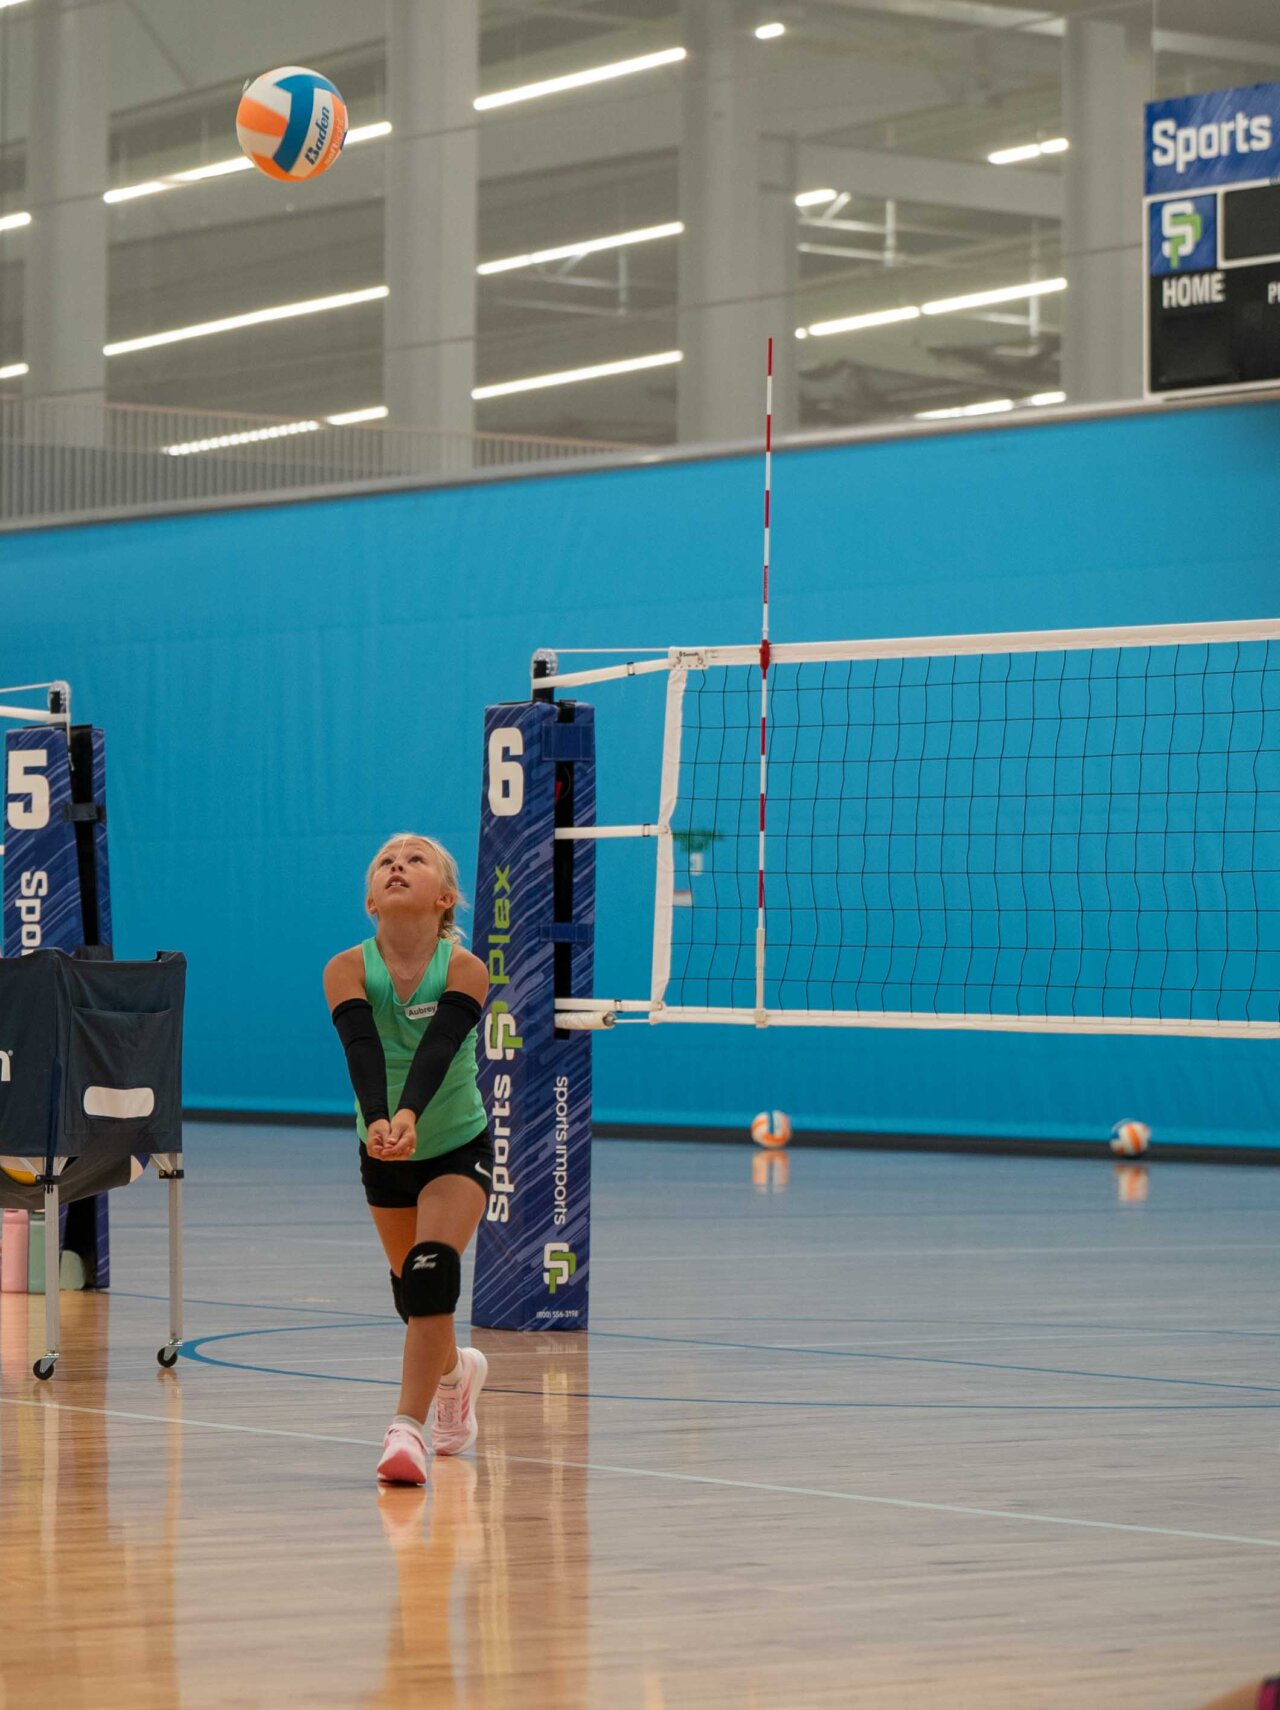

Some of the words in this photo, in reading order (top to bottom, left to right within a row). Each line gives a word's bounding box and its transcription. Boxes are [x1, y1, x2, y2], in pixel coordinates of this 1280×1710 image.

[304, 106, 330, 166] Baden
[1151, 110, 1272, 174] Sports
[1162, 270, 1226, 310] HOME
[7, 748, 50, 830] 5
[487, 727, 524, 817] 6
[15, 870, 49, 956] Spo
[488, 864, 511, 985] Plex
[408, 1004, 436, 1017] Aubrey
[486, 1073, 515, 1223] Sports
[553, 1076, 569, 1142] sports
[553, 1144, 568, 1226] imports
